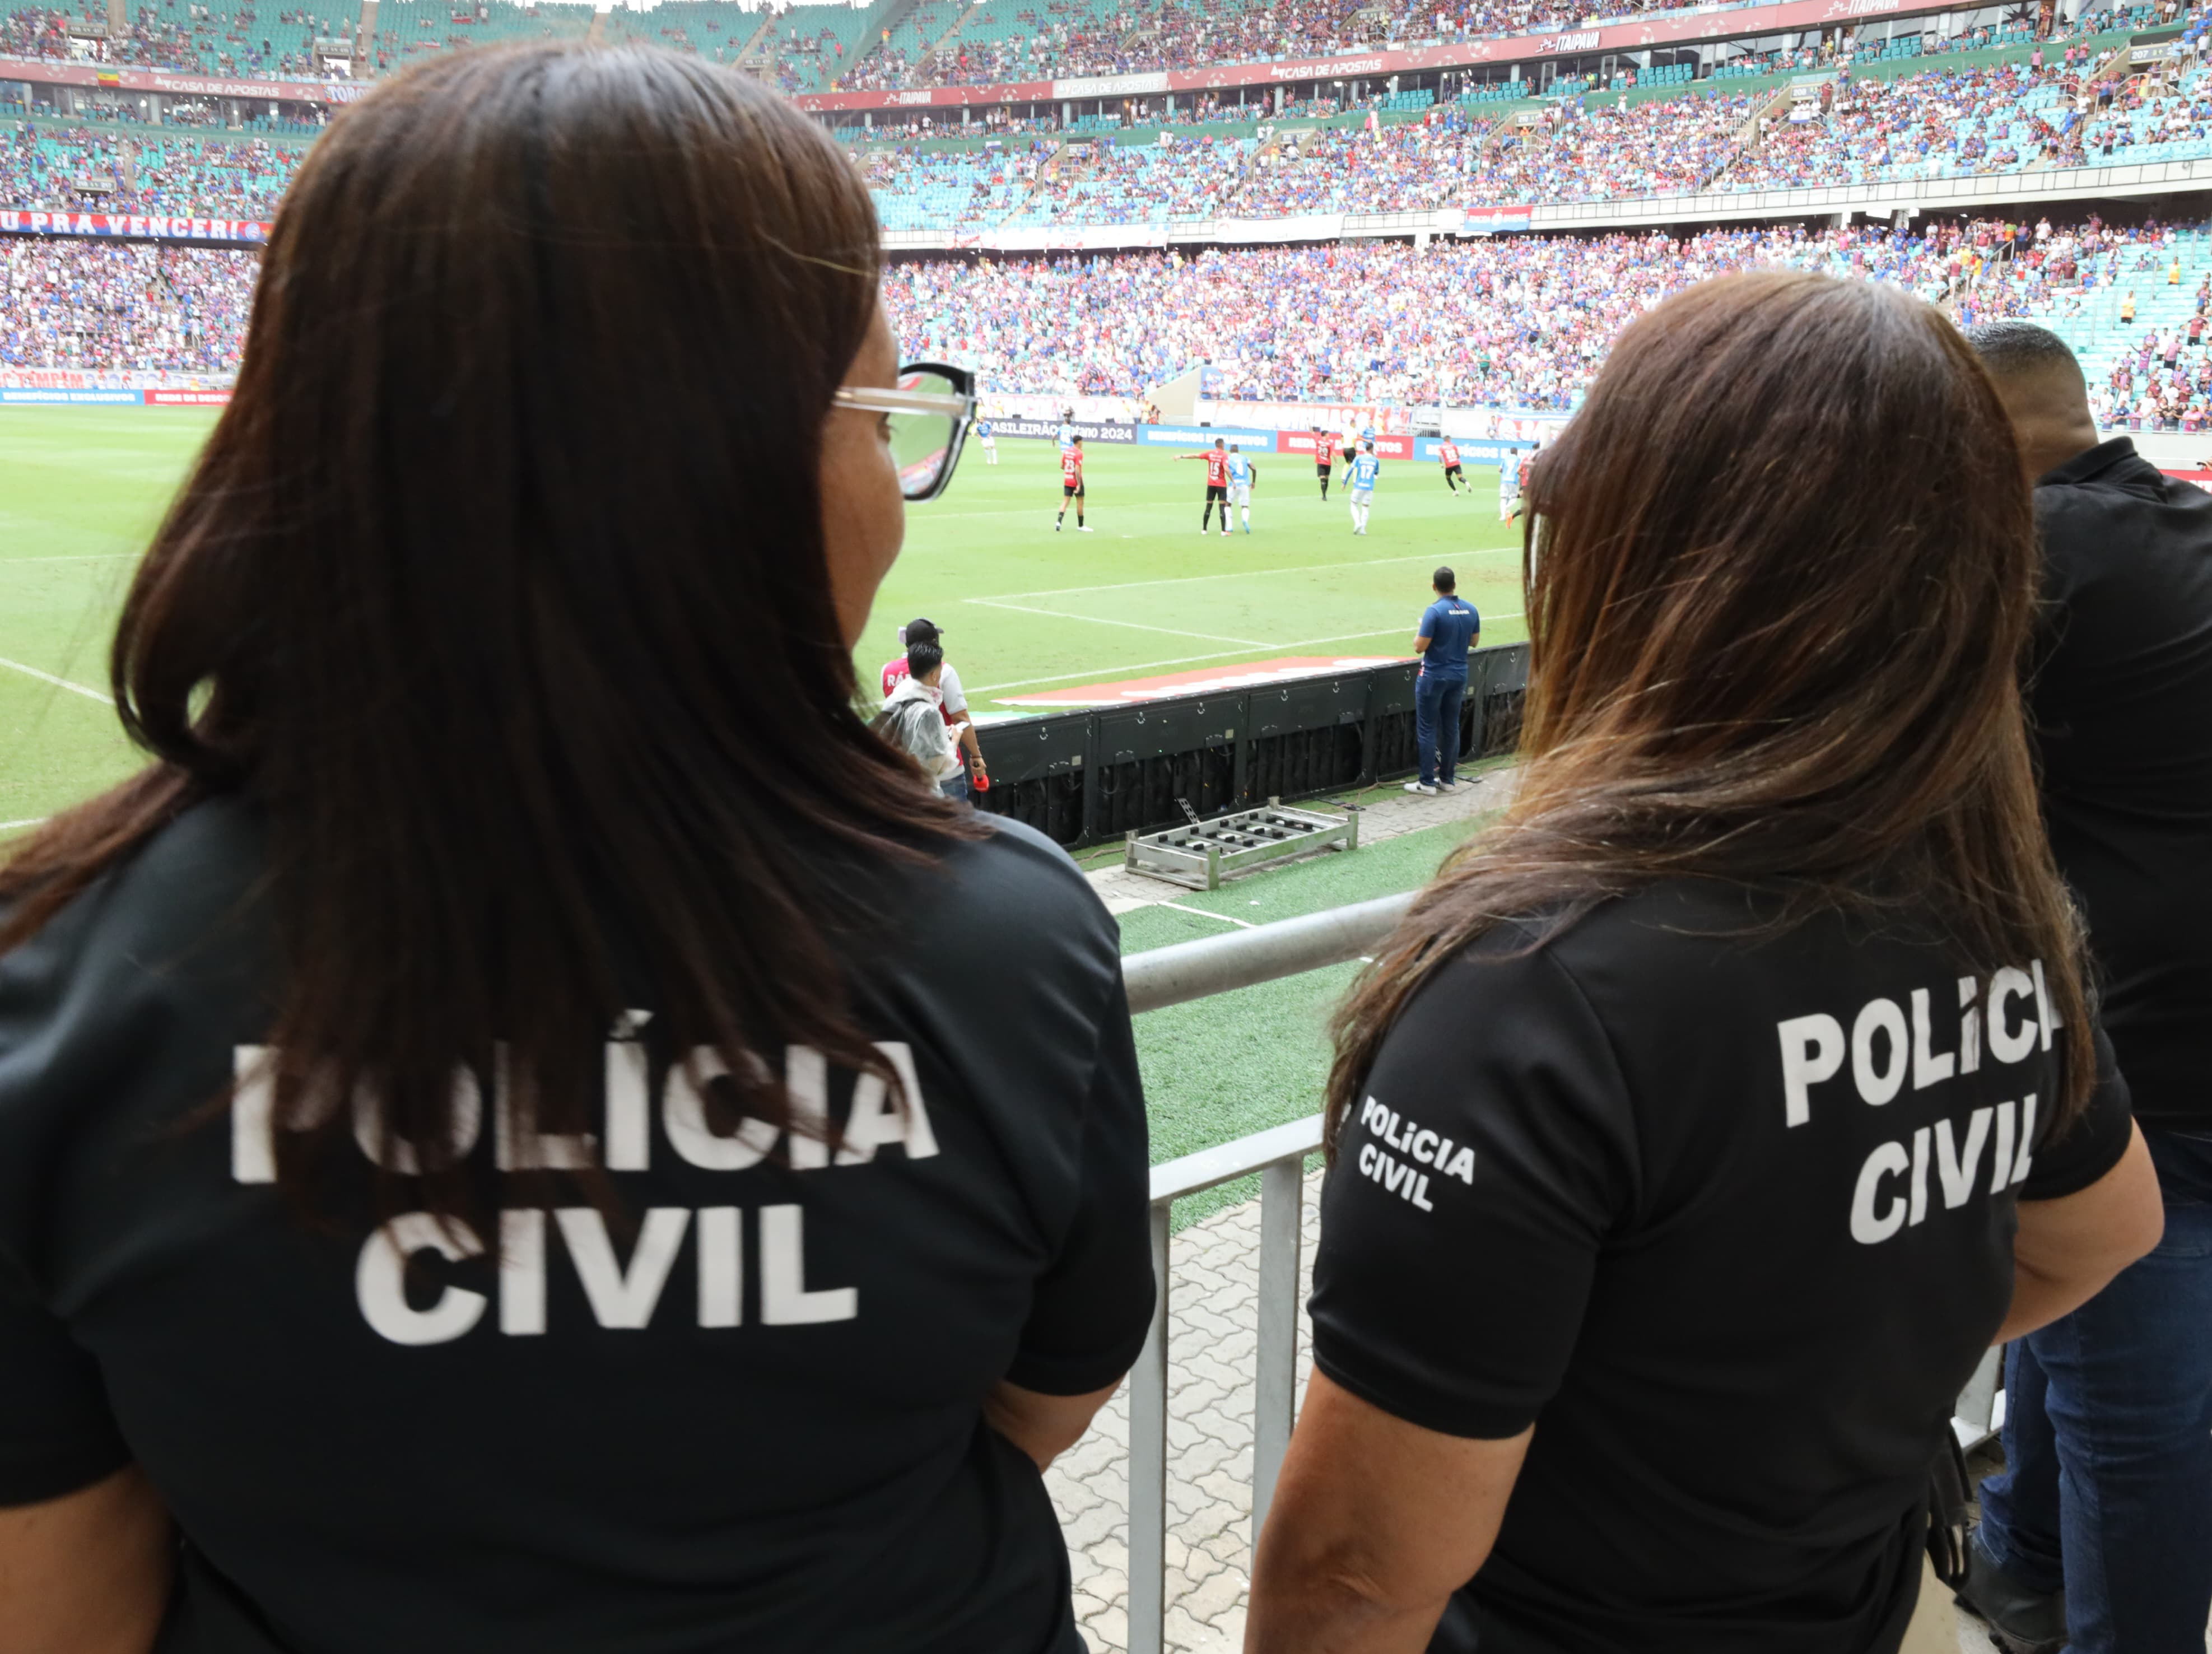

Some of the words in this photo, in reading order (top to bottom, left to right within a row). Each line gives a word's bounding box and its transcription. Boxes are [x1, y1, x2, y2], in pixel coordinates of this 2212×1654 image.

[1555, 31, 1600, 52] ITAIPAVA
[2131, 50, 2149, 59] 207
[1285, 66, 1313, 78] CASA
[1315, 64, 1330, 76] DE
[1331, 59, 1382, 74] APOSTAS
[172, 80, 204, 92] CASA
[207, 83, 223, 94] DE
[225, 84, 280, 96] APOSTAS
[1071, 84, 1096, 95] CASA
[1098, 82, 1111, 93] DE
[1113, 79, 1159, 92] APOSTAS
[899, 91, 931, 105] ITAIPAVA
[31, 213, 96, 234] PRA
[106, 216, 239, 240] VENCER!
[3, 390, 68, 400] BENEFÍCIOS
[69, 393, 136, 402] EXCLUSIVOS
[155, 393, 181, 402] REDE
[1100, 427, 1133, 440] 2024
[1147, 430, 1204, 442] BENEFÍCIOS
[1065, 459, 1075, 472] 23
[1210, 462, 1220, 476] 15
[1361, 465, 1374, 479] 17
[887, 671, 911, 687] RÁ
[1850, 1093, 2037, 1245] CIVIL
[1359, 1143, 1433, 1213] CIVIL
[355, 1204, 858, 1347] CIVIL
